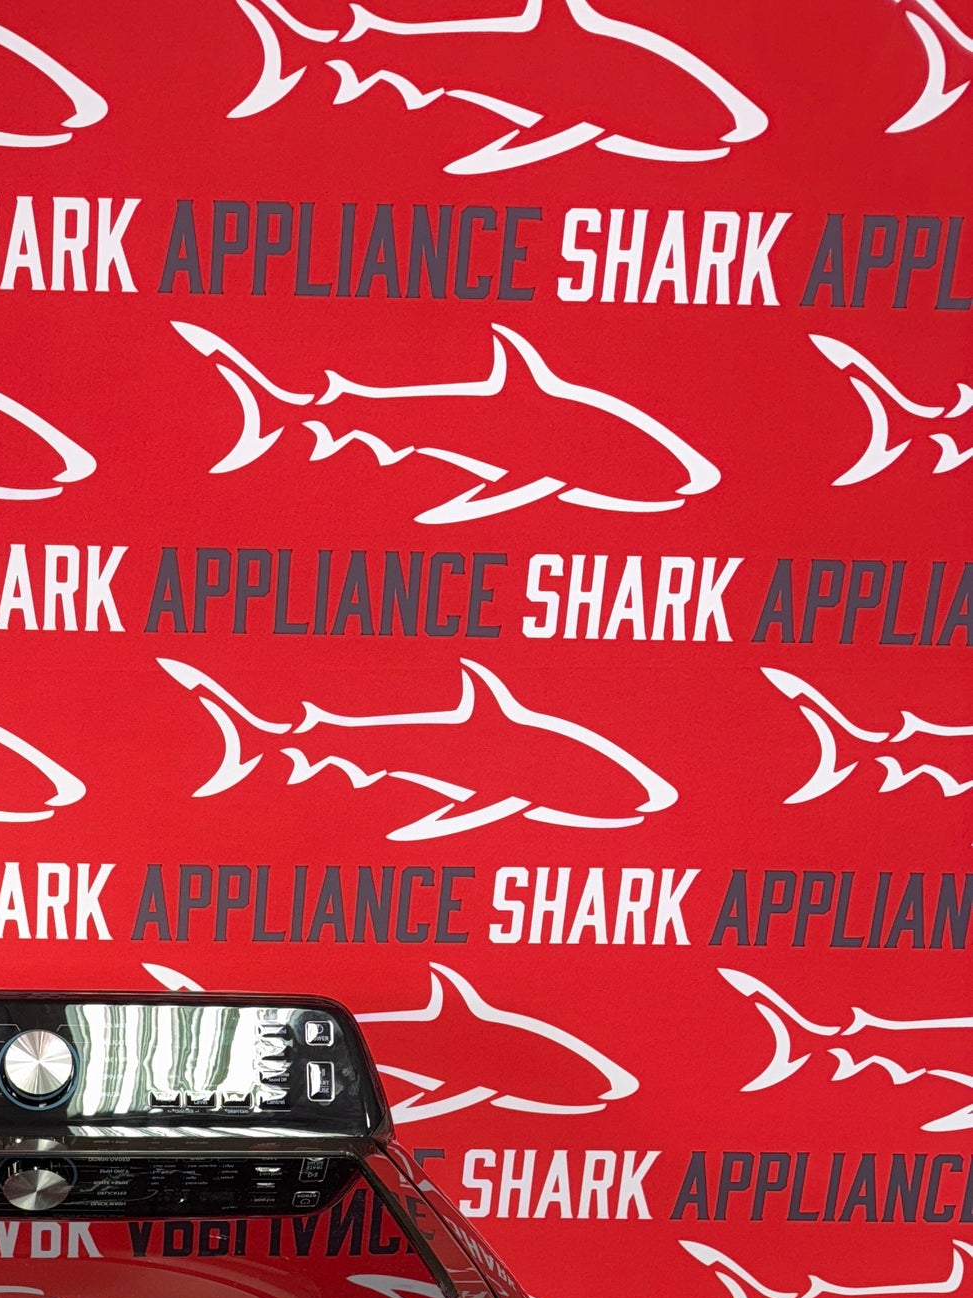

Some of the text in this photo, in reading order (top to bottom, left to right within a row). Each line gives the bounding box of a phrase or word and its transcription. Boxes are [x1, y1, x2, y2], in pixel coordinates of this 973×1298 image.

[158, 200, 542, 300] APPLIANCE
[557, 207, 793, 306] SHARK
[144, 547, 507, 638] APPLIANCE
[522, 553, 745, 642] SHARK
[131, 863, 476, 943] APPLIANCE
[488, 866, 702, 945] SHARK
[459, 1149, 662, 1220] SHARK
